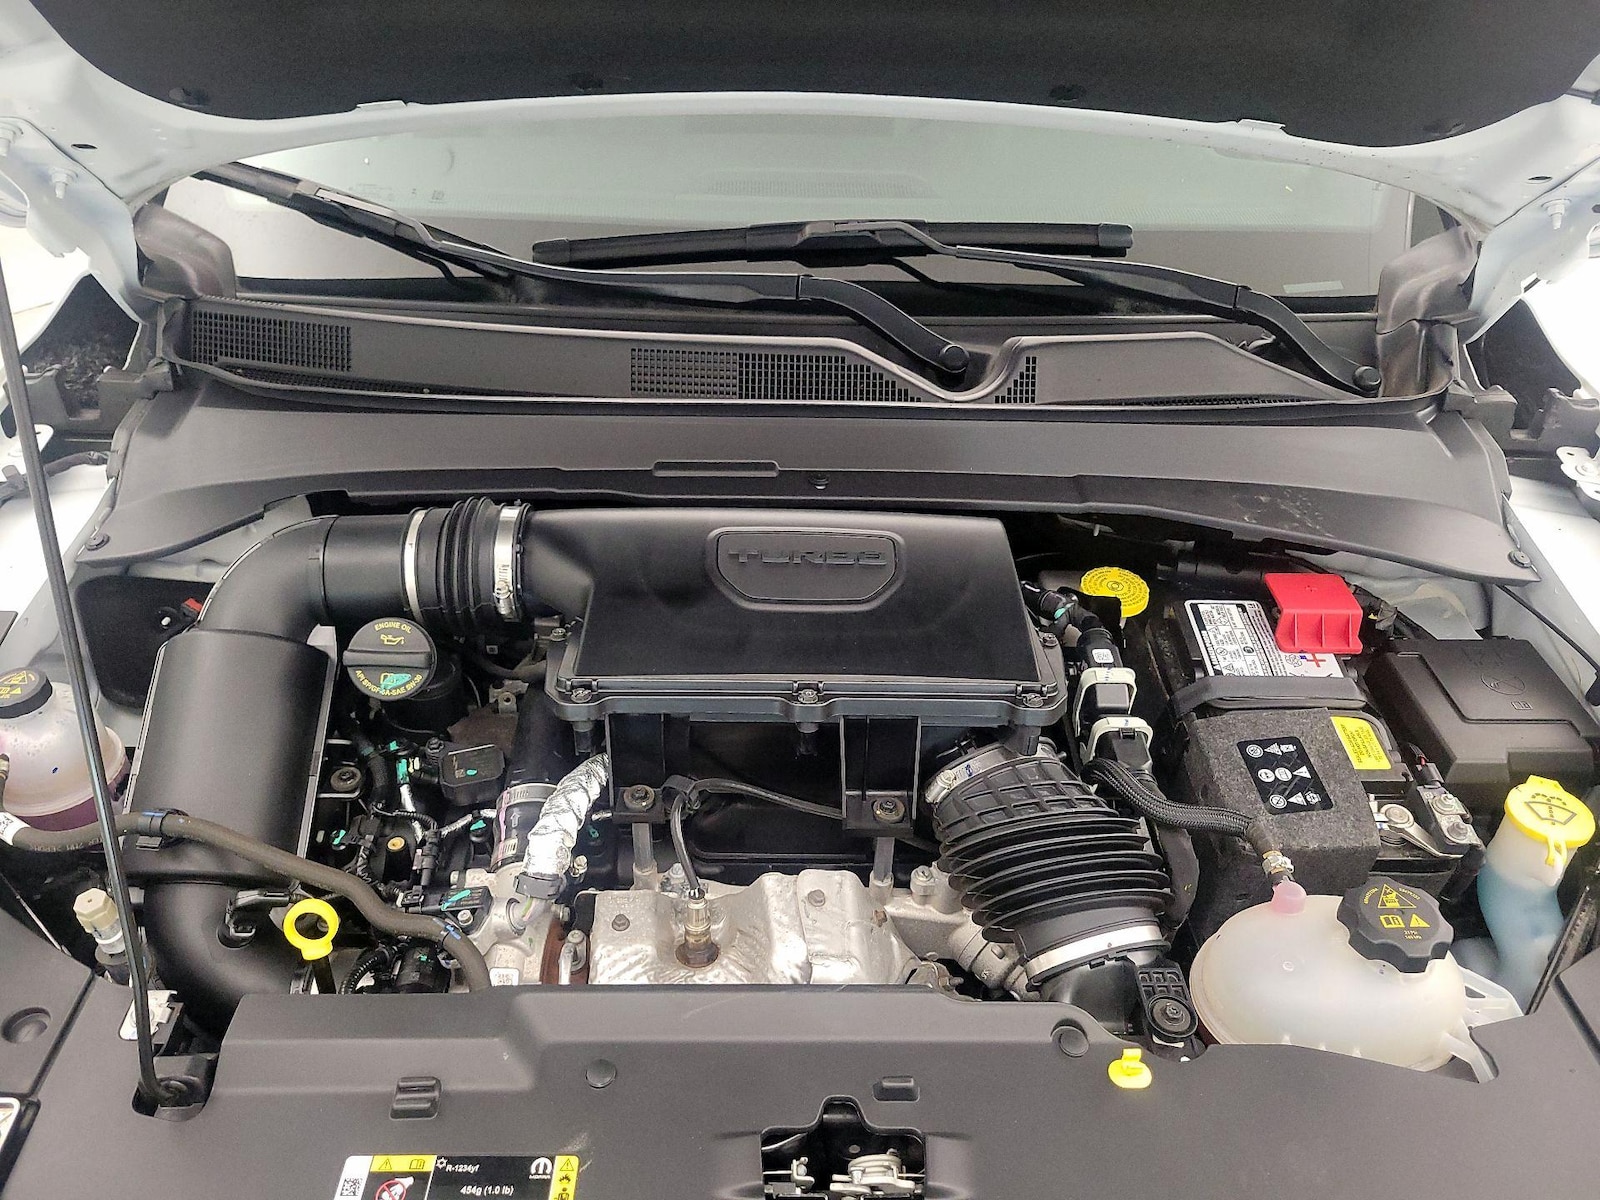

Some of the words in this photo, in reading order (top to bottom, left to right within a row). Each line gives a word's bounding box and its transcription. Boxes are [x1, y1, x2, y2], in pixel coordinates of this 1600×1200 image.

[728, 550, 887, 566] TURBO
[374, 621, 401, 631] ENGINE
[401, 623, 412, 634] OIL
[446, 1164, 480, 1173] R-1234yf
[460, 1186, 482, 1196] 454g
[484, 1186, 499, 1196] (1.0
[502, 1186, 514, 1196] lb)
